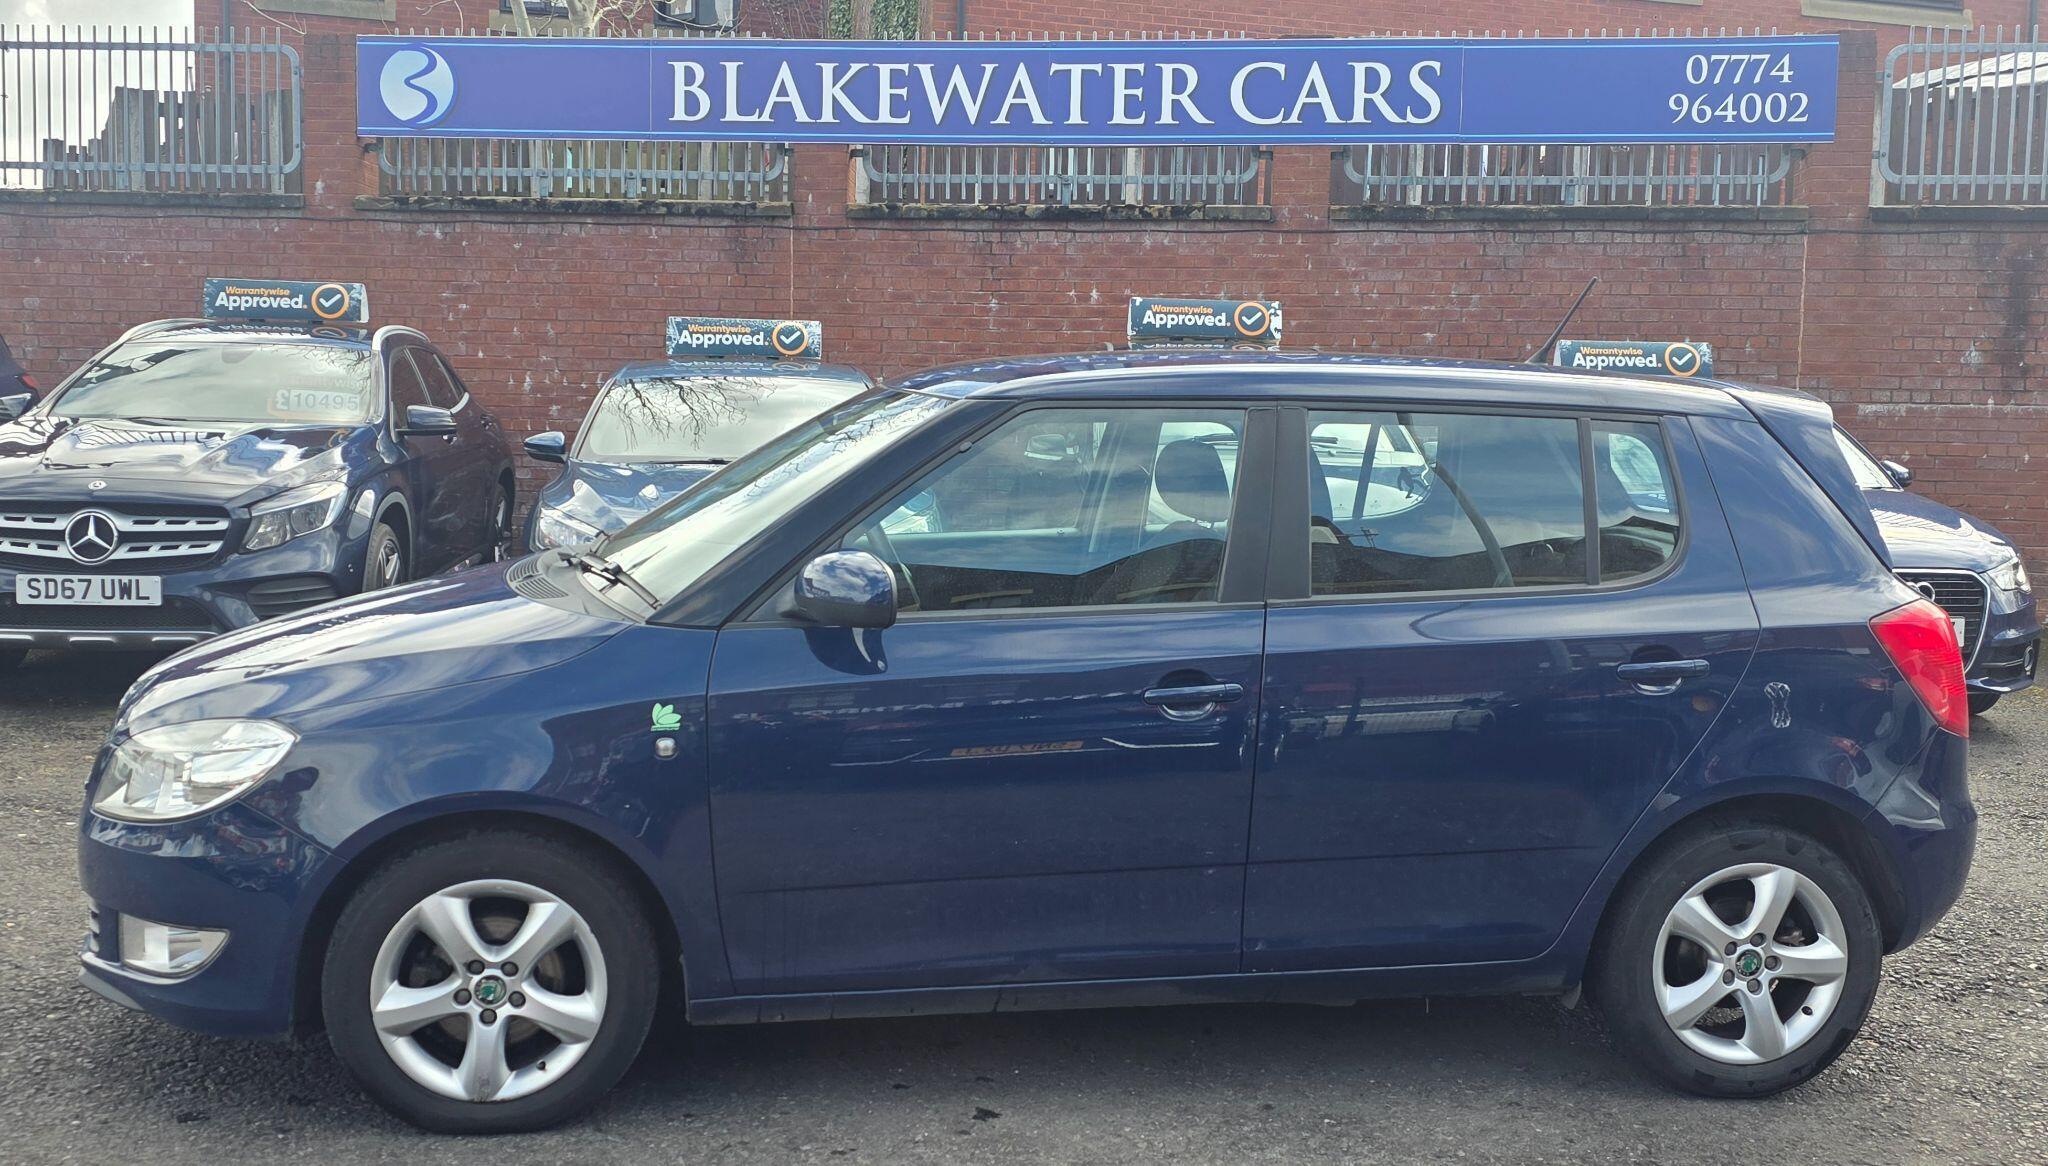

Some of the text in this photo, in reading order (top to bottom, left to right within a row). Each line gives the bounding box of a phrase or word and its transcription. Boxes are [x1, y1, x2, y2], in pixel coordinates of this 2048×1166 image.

[1685, 53, 1794, 85] 07774
[667, 60, 1442, 126] BLAKEWATER CARS
[1668, 92, 1809, 124] 964002
[225, 286, 290, 296] Warrantywise
[215, 292, 308, 311] Approved.
[1151, 304, 1214, 314] Warrantywise
[687, 324, 752, 334] Warrantywise
[1142, 310, 1231, 329] Approved.
[678, 329, 769, 348] Approved.
[1580, 346, 1643, 355] Warrantywise
[1572, 352, 1662, 371] Approved.
[275, 389, 360, 412] £10495
[27, 577, 150, 601] SD67 UWL
